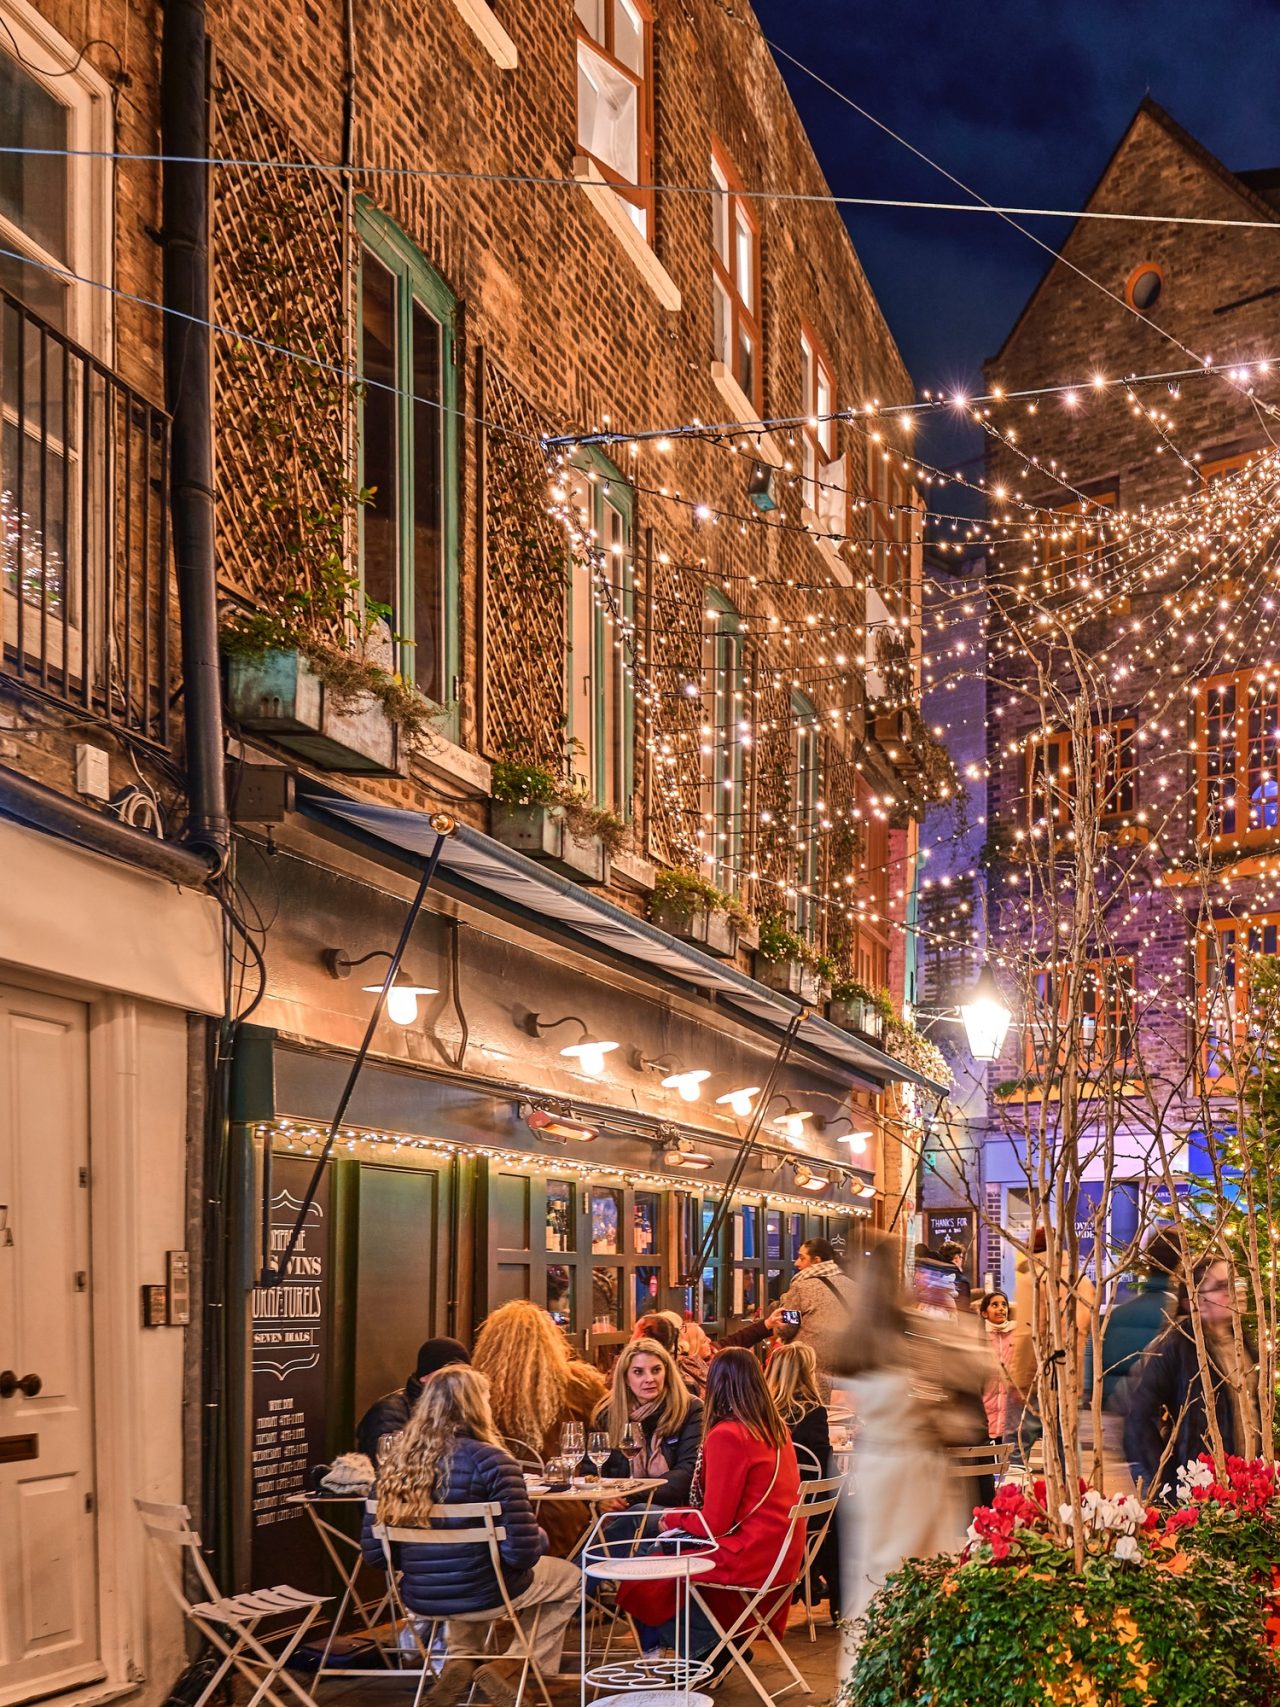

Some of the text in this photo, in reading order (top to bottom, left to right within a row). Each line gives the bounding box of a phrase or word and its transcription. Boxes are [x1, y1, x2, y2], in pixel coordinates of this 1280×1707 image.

[930, 1217, 967, 1228] THANKS FOR
[287, 1256, 322, 1276] VINS
[252, 1286, 321, 1318] URNATURELS
[254, 1331, 311, 1343] SEVEN DIALS
